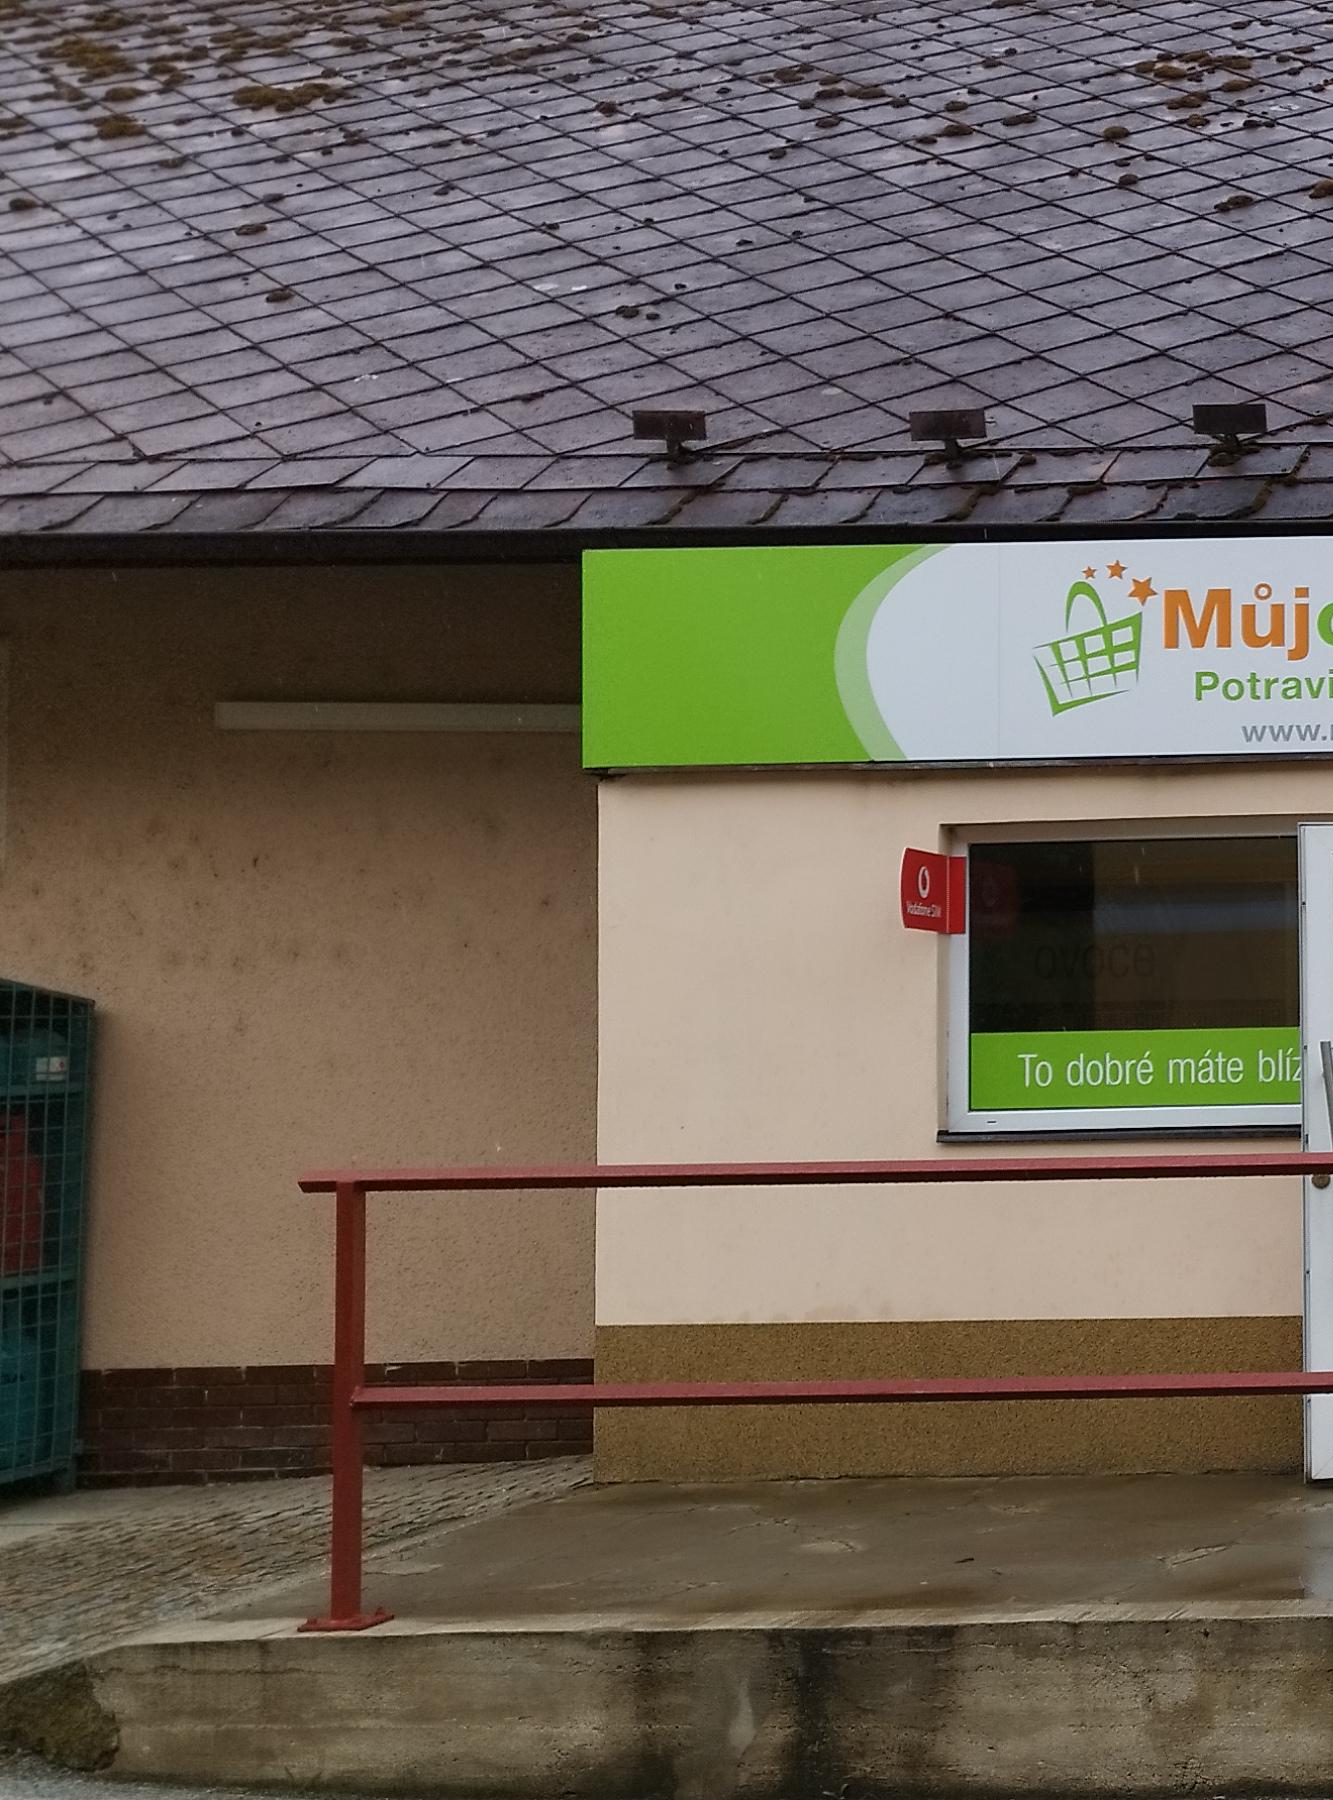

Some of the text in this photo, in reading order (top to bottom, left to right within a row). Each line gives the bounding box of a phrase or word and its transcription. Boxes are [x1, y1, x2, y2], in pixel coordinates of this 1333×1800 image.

[1017, 1053, 1054, 1088] To
[1066, 1050, 1154, 1087] dobré
[1168, 1049, 1244, 1085] máte
